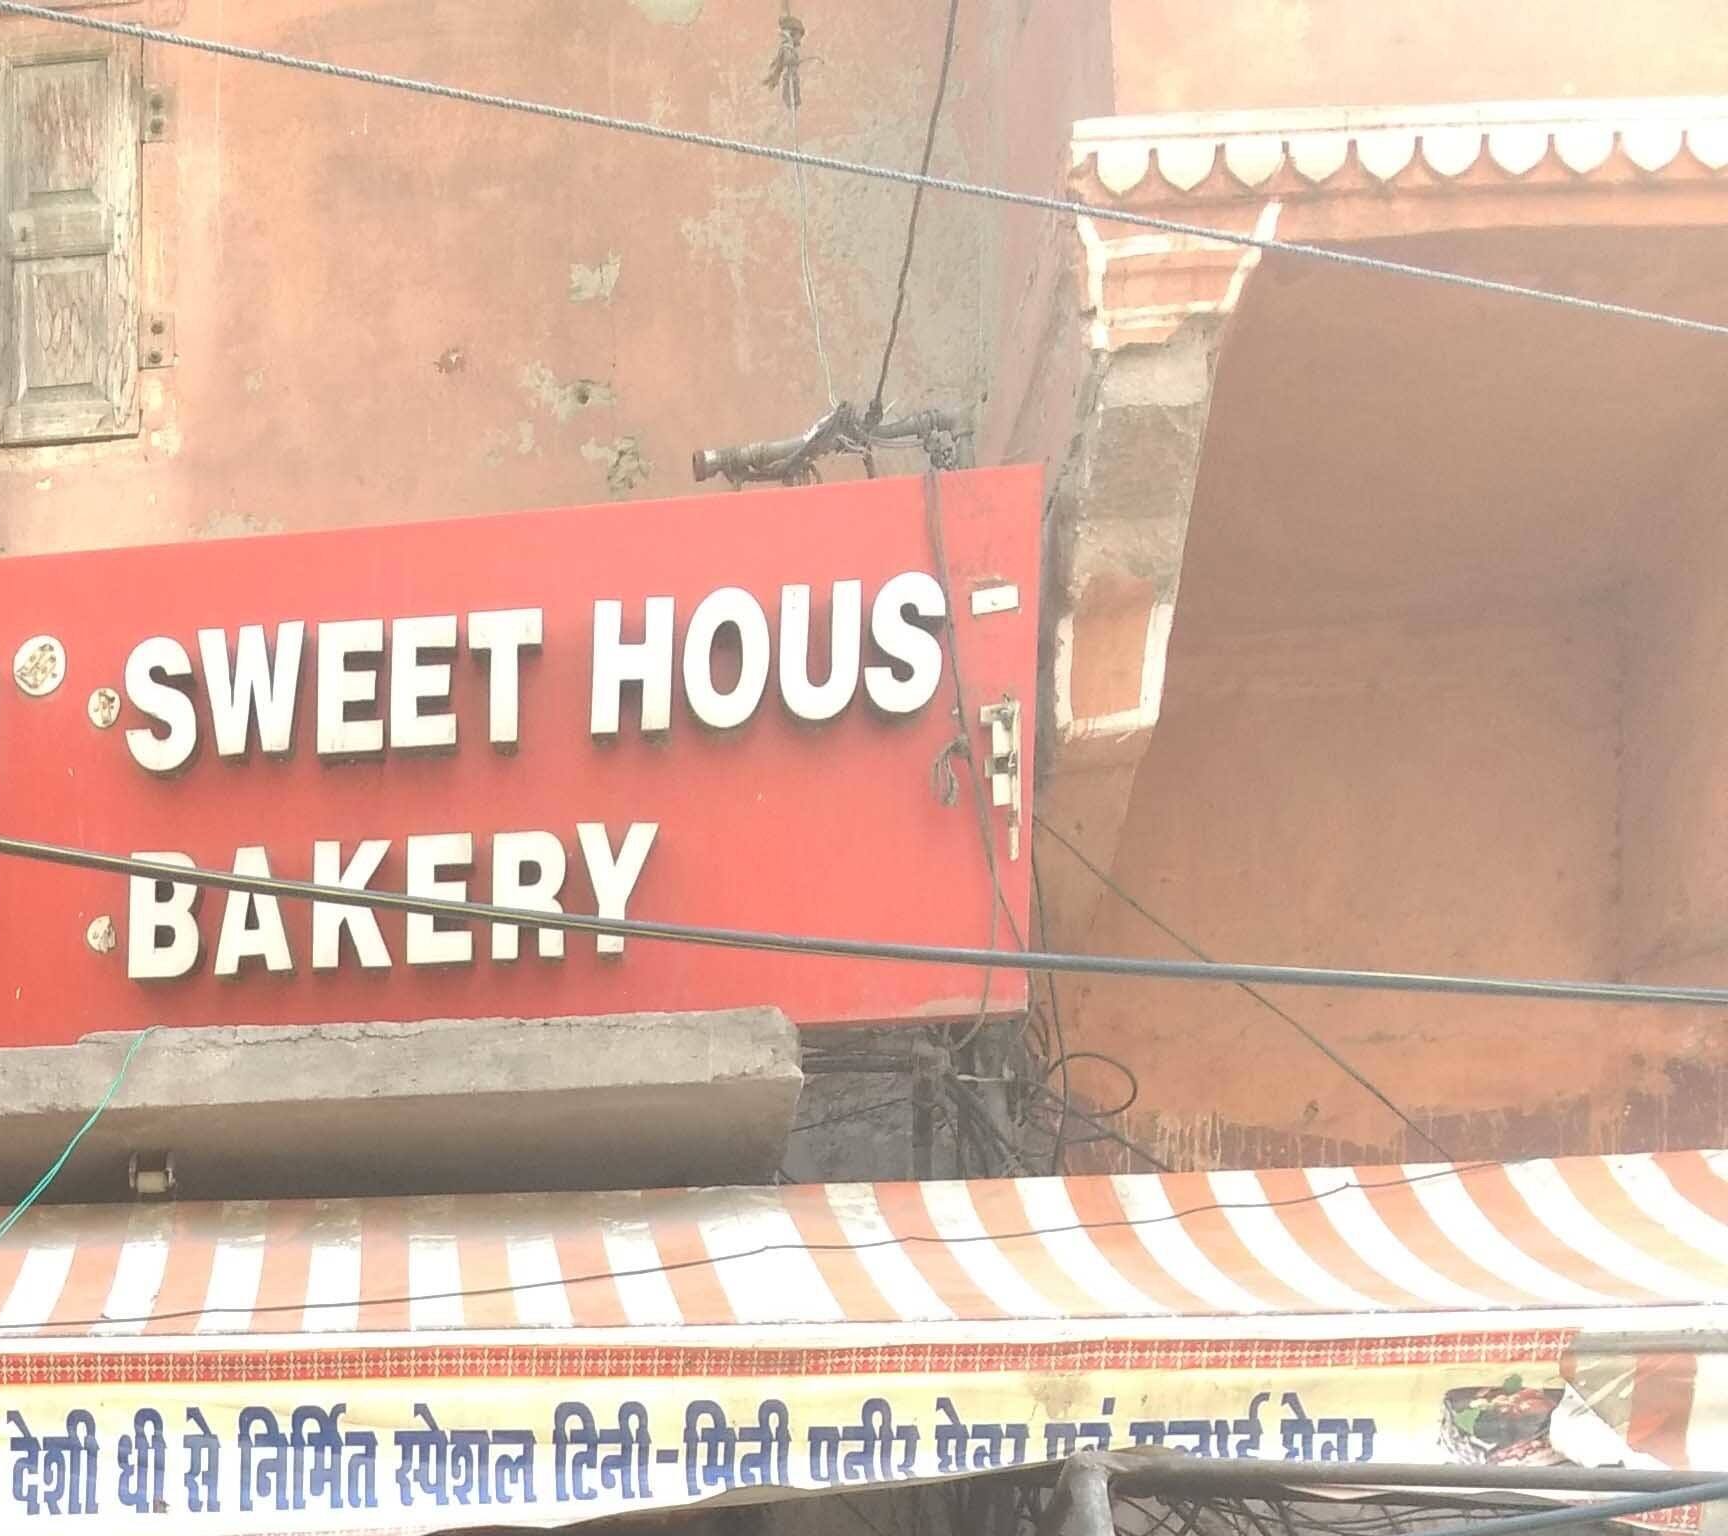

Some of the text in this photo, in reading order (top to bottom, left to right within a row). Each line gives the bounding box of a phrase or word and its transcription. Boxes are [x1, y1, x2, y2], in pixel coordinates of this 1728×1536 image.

[125, 606, 544, 774] SWEET
[127, 820, 660, 980] BAKERY
[6, 1406, 101, 1516] देशी
[182, 1405, 222, 1513] से
[237, 1402, 380, 1513] निर्मित
[394, 1402, 539, 1506] स्पेशल
[553, 1398, 791, 1502] टिनी-मिनी
[807, 1397, 919, 1488] पनीर
